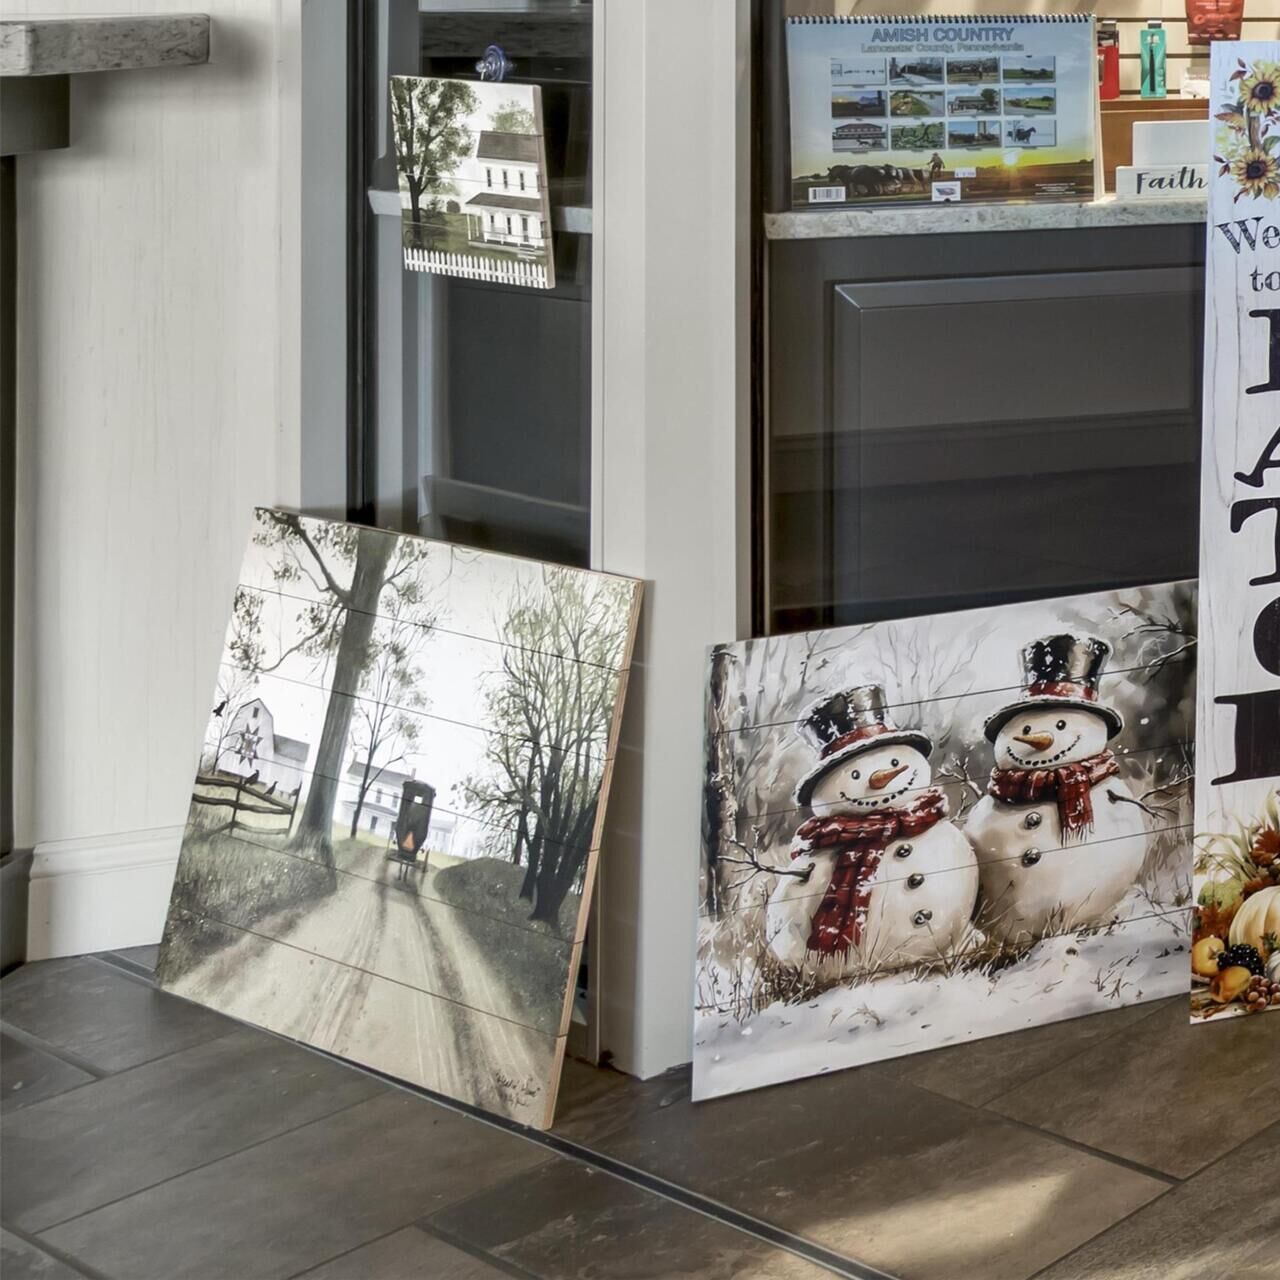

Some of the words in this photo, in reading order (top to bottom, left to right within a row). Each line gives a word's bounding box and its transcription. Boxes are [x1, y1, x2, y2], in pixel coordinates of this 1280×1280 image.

[872, 27, 929, 42] AMISH
[933, 27, 1015, 42] COUNTRY
[861, 43, 914, 54] Lancaster
[916, 43, 954, 54] County,
[957, 42, 1025, 54] Pennsylvania
[1136, 166, 1208, 195] Faith
